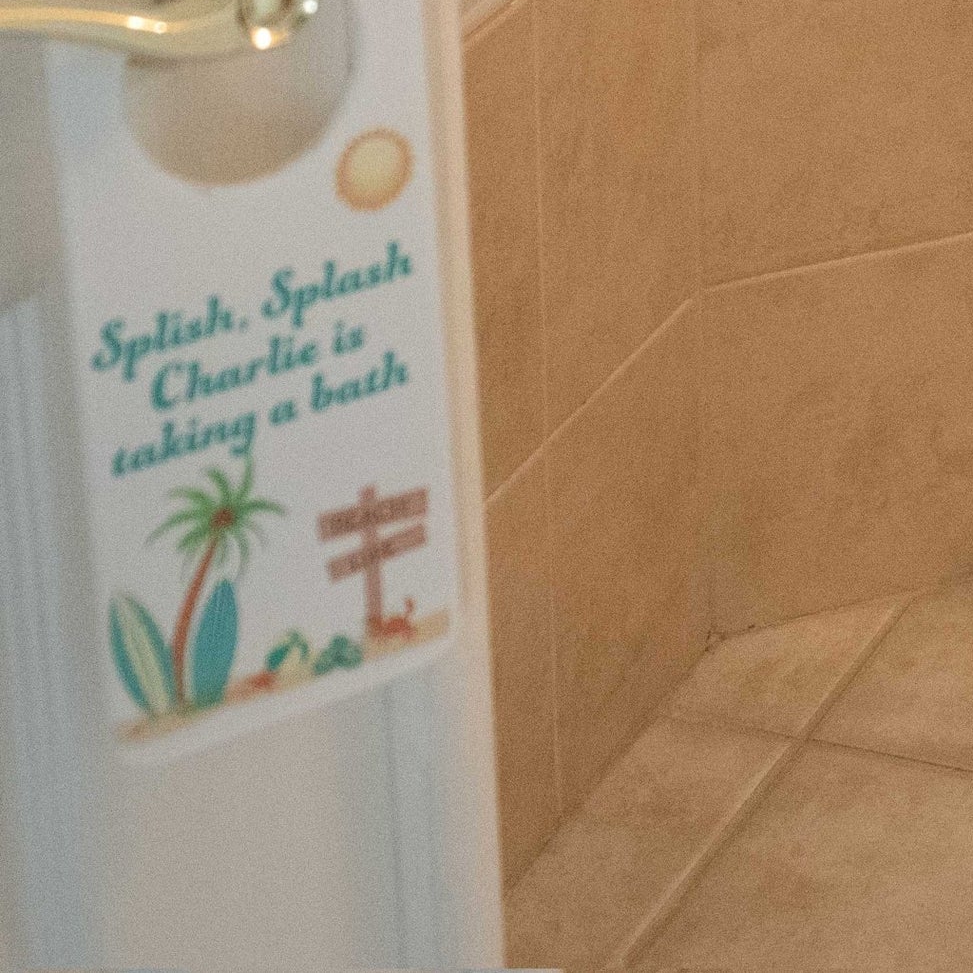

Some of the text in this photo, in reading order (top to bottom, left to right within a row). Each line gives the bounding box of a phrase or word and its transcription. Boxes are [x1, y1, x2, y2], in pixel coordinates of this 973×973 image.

[261, 240, 412, 329] Splash
[151, 320, 364, 411] Charlie is
[111, 351, 408, 477] taking a bath
